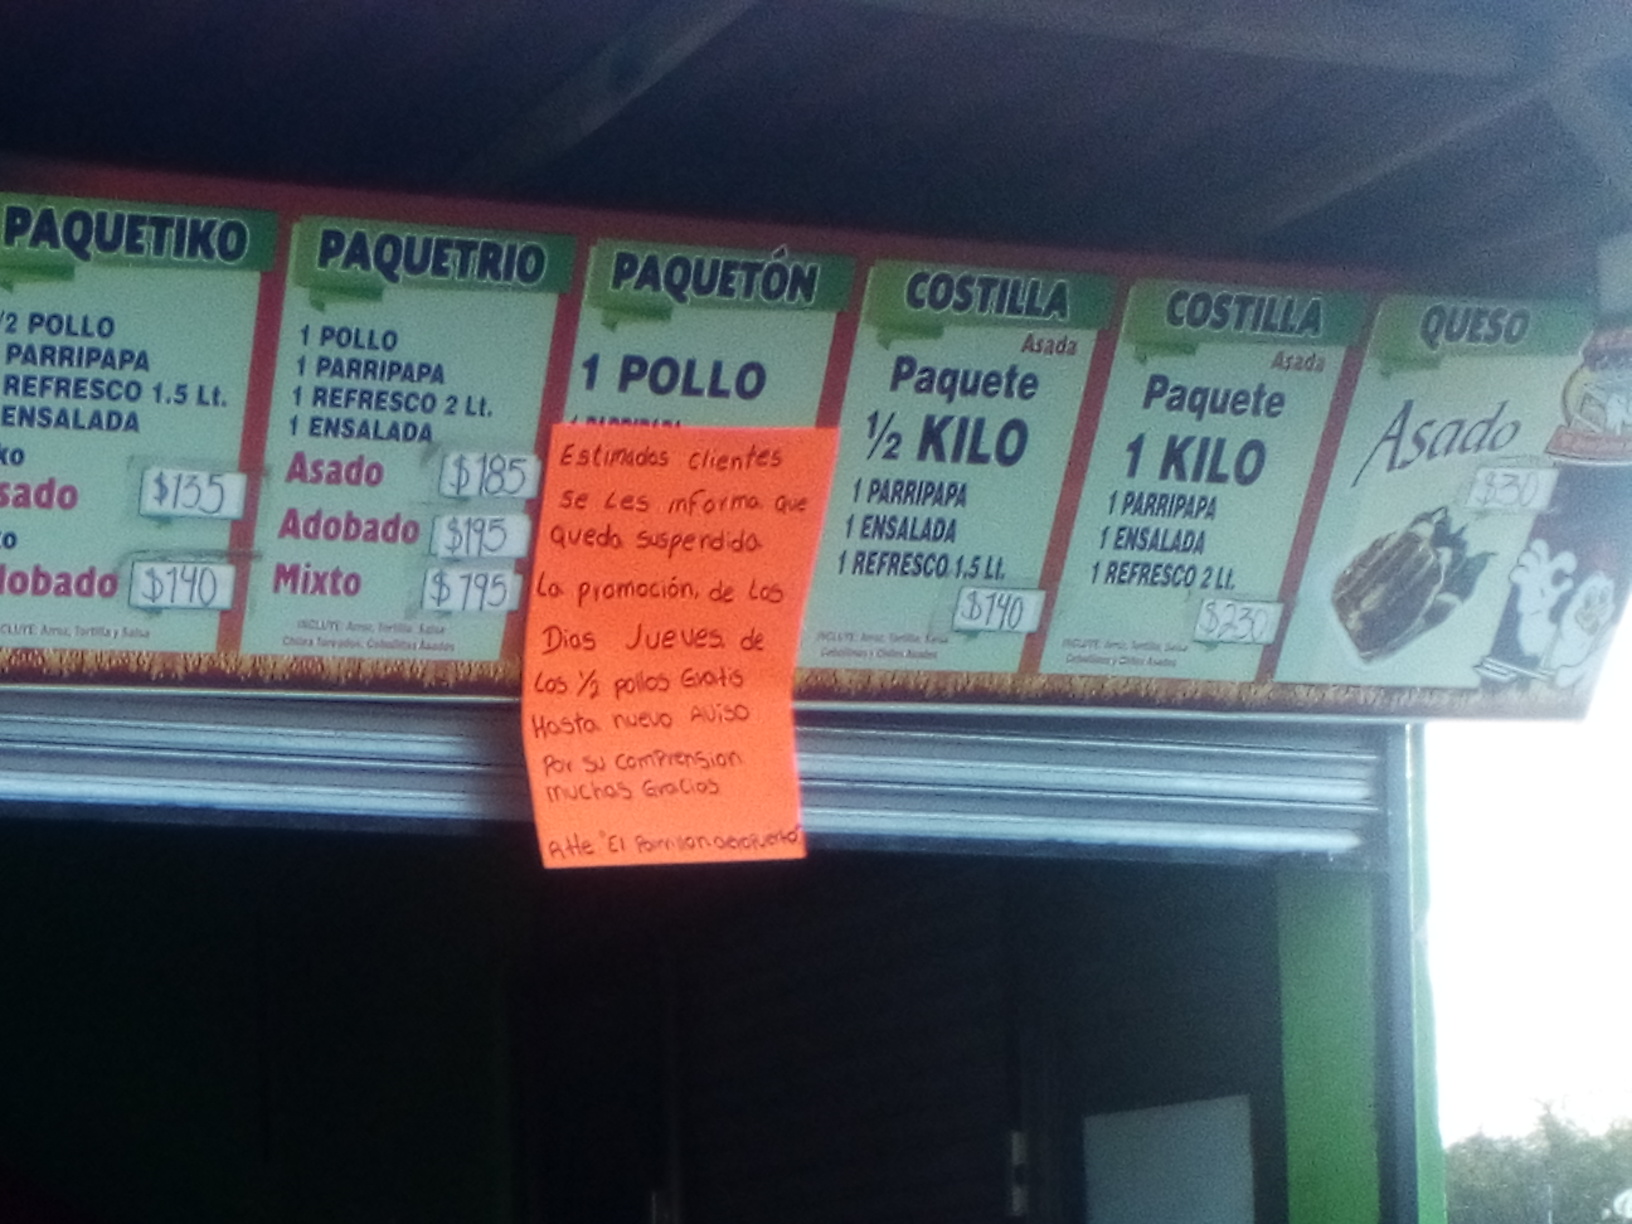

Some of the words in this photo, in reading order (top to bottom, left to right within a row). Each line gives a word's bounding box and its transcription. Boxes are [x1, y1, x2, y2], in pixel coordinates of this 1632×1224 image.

[4, 205, 249, 264] PAQUETIKO
[318, 229, 547, 284] PAQUETRIO
[612, 245, 819, 303] PAQUETÓN
[905, 270, 1069, 321] COSTILLA
[28, 312, 115, 338] POLLO
[1167, 289, 1322, 337] COSTILLA
[1420, 303, 1531, 352] QUESO
[301, 324, 309, 346] 1
[320, 326, 398, 352] POLLO
[1021, 333, 1077, 356] Asada
[6, 343, 150, 373] PARRIPAPA
[297, 355, 306, 377] 1
[316, 356, 445, 384] PARRIPAPA
[1271, 351, 1325, 372] Asada
[3, 374, 142, 402] REFRESCO
[153, 384, 187, 405] 1.5
[197, 384, 226, 407] Lt.
[582, 353, 600, 391] 1
[618, 354, 767, 401] POLLO
[890, 355, 1039, 403] Paquete
[293, 386, 301, 406] 1
[313, 387, 435, 414] REFRESCO
[443, 395, 458, 415] 2
[465, 396, 492, 418] Lt.
[1143, 374, 1285, 422] Paquete
[1, 405, 140, 433] ENSALADA
[290, 415, 298, 436] 1
[310, 416, 433, 442] ENSALADA
[560, 443, 669, 468] Estimados
[917, 414, 1028, 467] KILO
[1351, 399, 1521, 488] Asado
[285, 451, 383, 487] Asado
[450, 453, 527, 496] $185
[1126, 433, 1145, 479] 1
[1159, 435, 1266, 486] KILO
[154, 471, 224, 514] $135
[854, 478, 862, 502] 1
[867, 479, 967, 507] PARRIPAPA
[1109, 490, 1117, 515] 1
[1122, 491, 1217, 520] PARRIPAPA
[278, 508, 420, 544] Adobado
[447, 517, 507, 557] $195
[846, 514, 854, 538] 1
[860, 515, 956, 543] ENSALADA
[1101, 526, 1110, 549] 1
[1114, 526, 1206, 555] ENSALADA
[273, 563, 361, 597] Mixto
[838, 550, 847, 574] 1
[852, 550, 948, 578] REFRESCO
[955, 554, 980, 580] 1.5
[1092, 561, 1099, 584] 1
[1105, 561, 1196, 588] REFRESCO
[1200, 566, 1213, 589] 2
[142, 566, 216, 606] $140
[710, 580, 734, 603] de
[961, 589, 1024, 631] $140
[1199, 603, 1268, 642] $230
[740, 627, 765, 651] de
[614, 673, 670, 699] pollos
[532, 712, 600, 739] Hasta
[614, 711, 672, 730] nuevo
